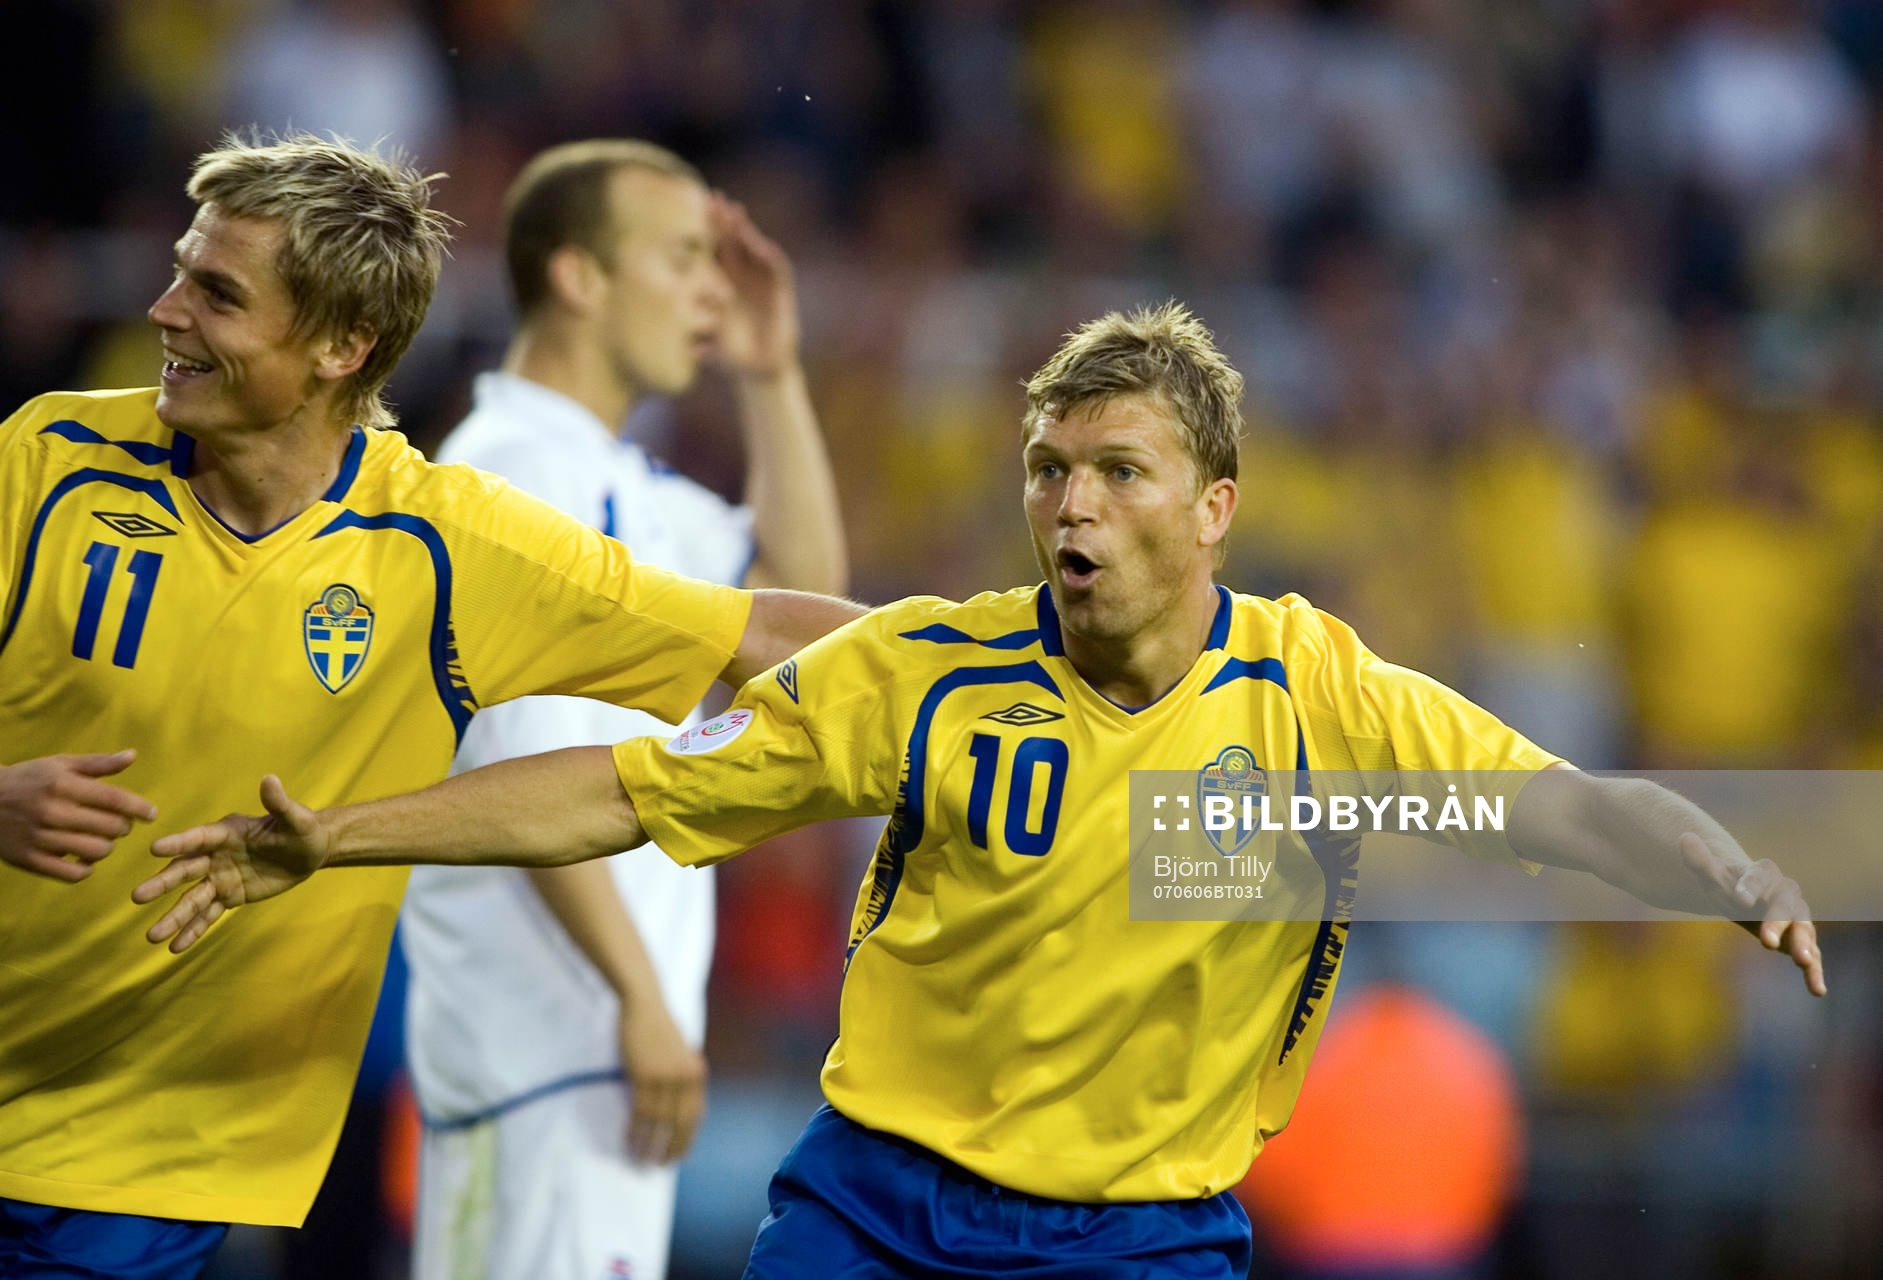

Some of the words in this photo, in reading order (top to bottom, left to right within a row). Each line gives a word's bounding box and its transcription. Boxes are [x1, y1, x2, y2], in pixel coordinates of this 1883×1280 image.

[72, 541, 164, 670] 11
[967, 733, 1070, 857] 10
[1217, 779, 1252, 791] SvFF
